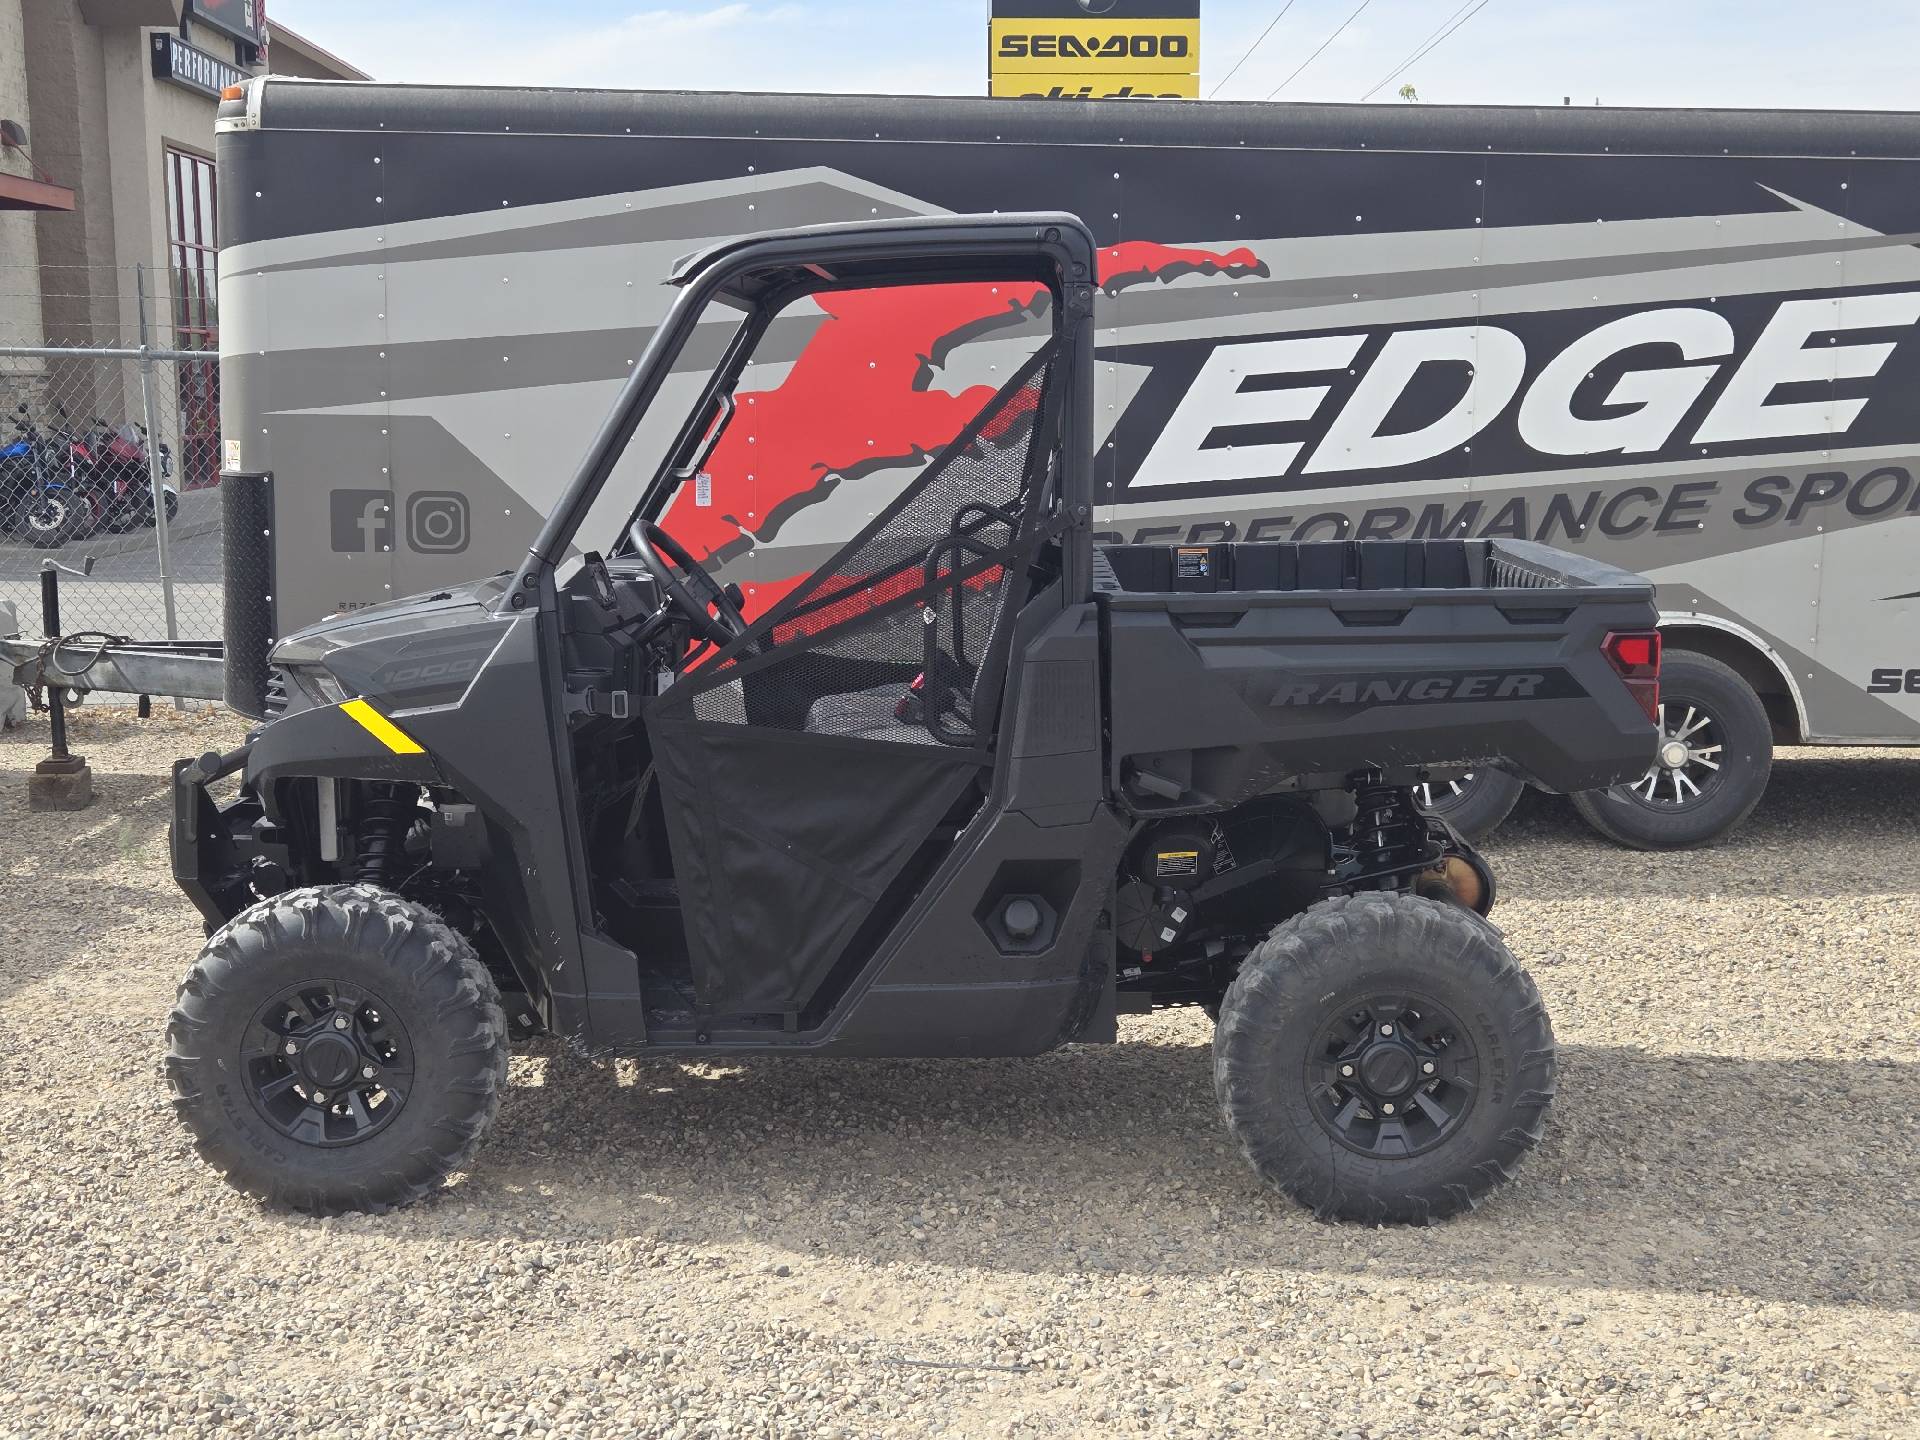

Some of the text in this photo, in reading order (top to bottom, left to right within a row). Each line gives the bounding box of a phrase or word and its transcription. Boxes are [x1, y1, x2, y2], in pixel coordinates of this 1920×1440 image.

[171, 41, 243, 90] PERFORMAN
[1128, 291, 1920, 488] EDGE
[1093, 466, 1920, 545] FORMANCE SPO
[1269, 674, 1545, 707] RANGER
